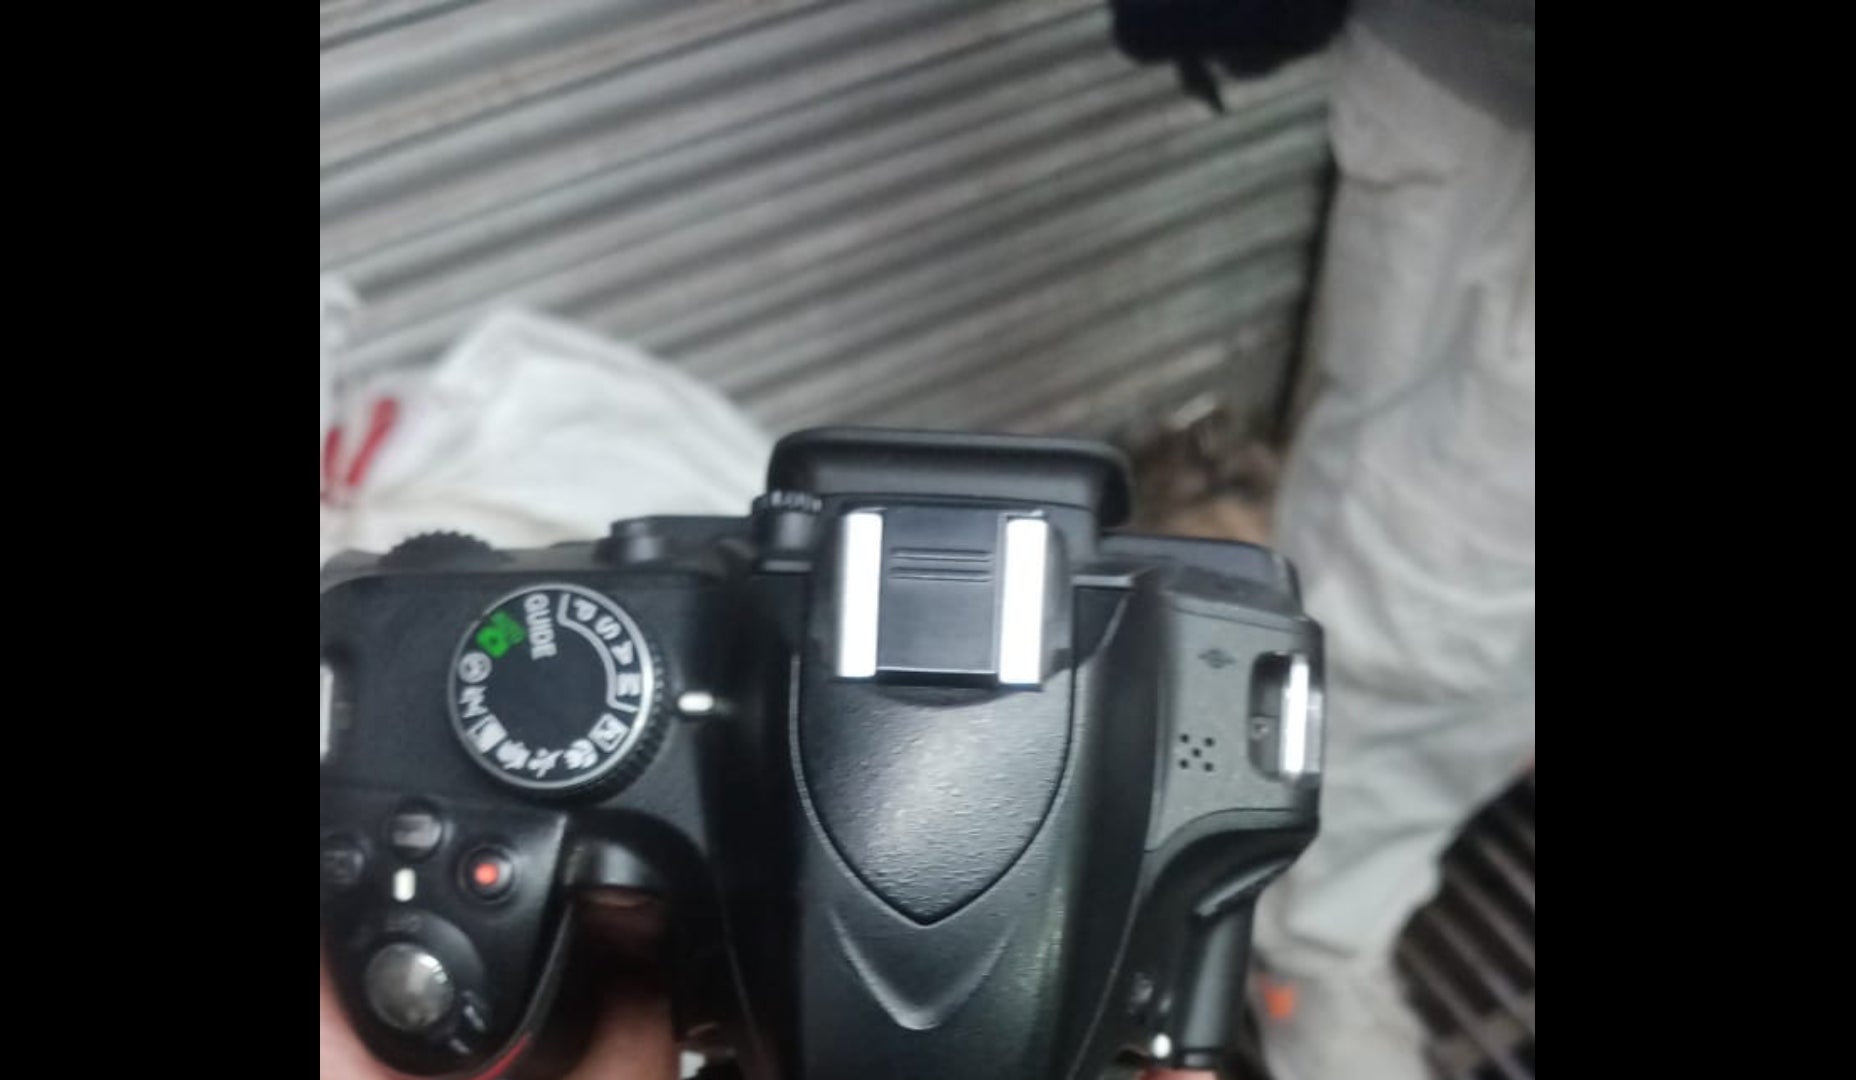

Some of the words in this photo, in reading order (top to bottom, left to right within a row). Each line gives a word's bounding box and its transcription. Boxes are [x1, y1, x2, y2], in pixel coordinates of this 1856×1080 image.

[572, 598, 599, 622] P
[523, 593, 558, 661] GUIDE
[594, 615, 622, 640] S
[611, 640, 634, 666] A
